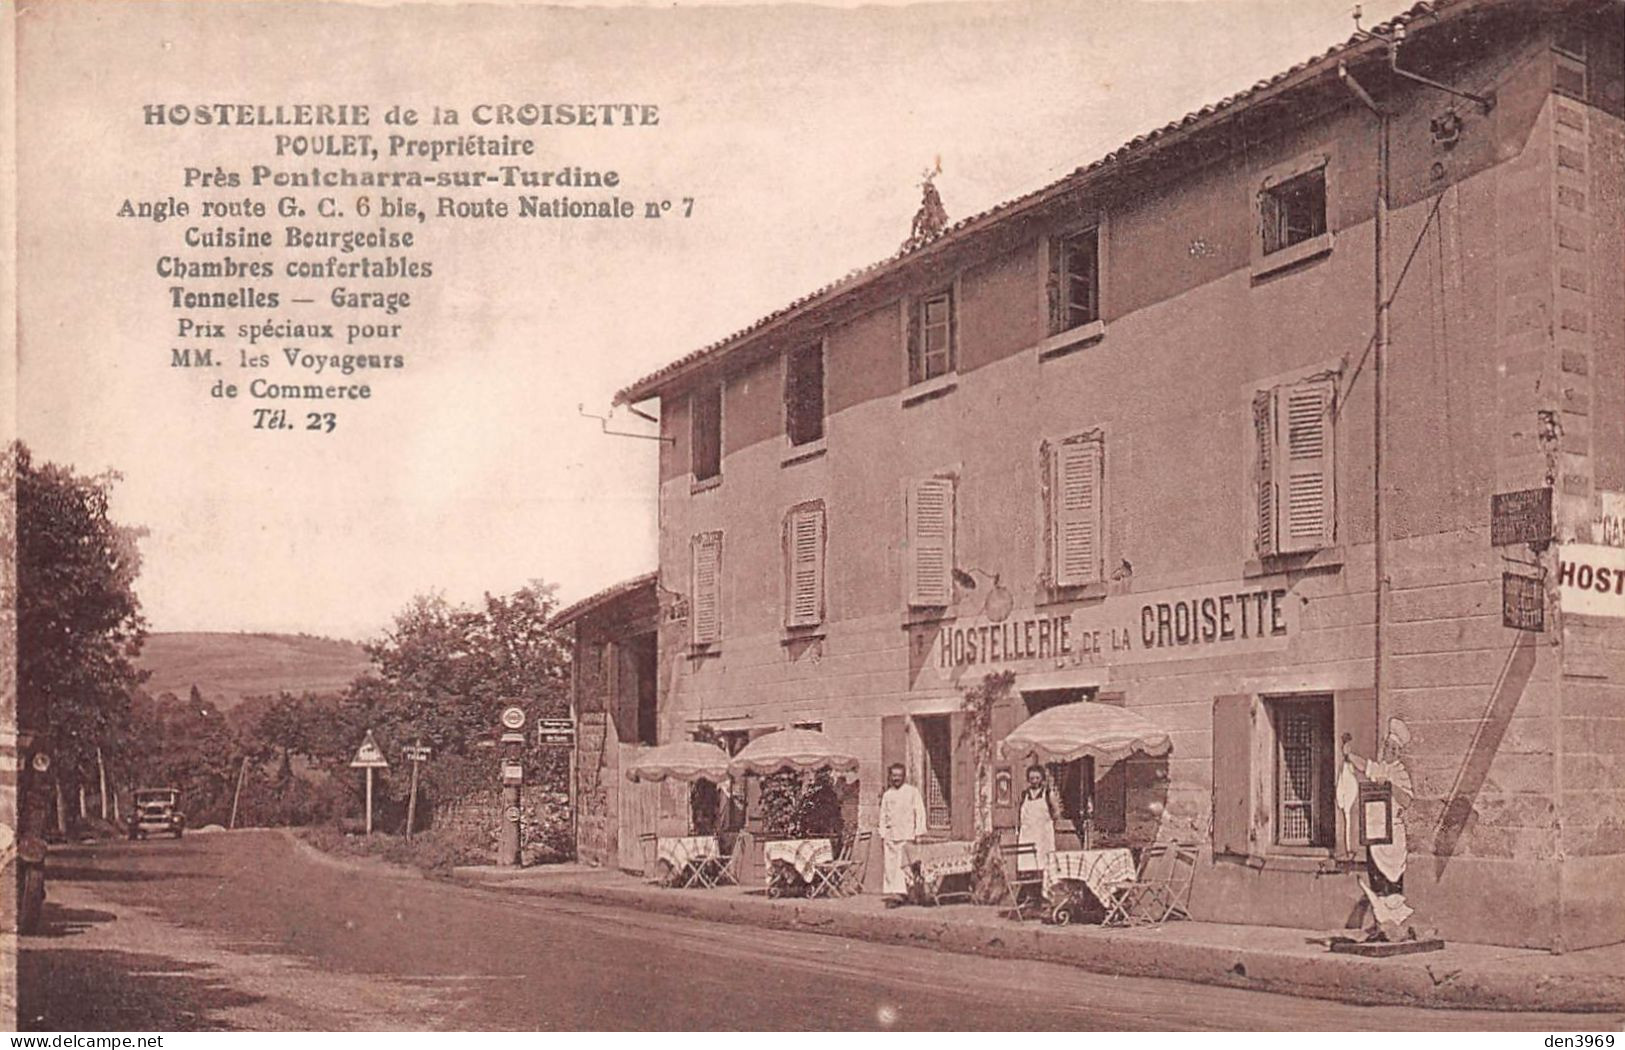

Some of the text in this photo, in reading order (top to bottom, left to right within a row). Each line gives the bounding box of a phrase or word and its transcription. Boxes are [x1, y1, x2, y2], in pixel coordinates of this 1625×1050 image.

[1558, 561, 1625, 595] HOST
[939, 615, 1073, 668] HOSTELLERIE
[1083, 630, 1101, 653] DE
[1112, 627, 1131, 651] LA
[1141, 588, 1287, 650] CROISETTE
